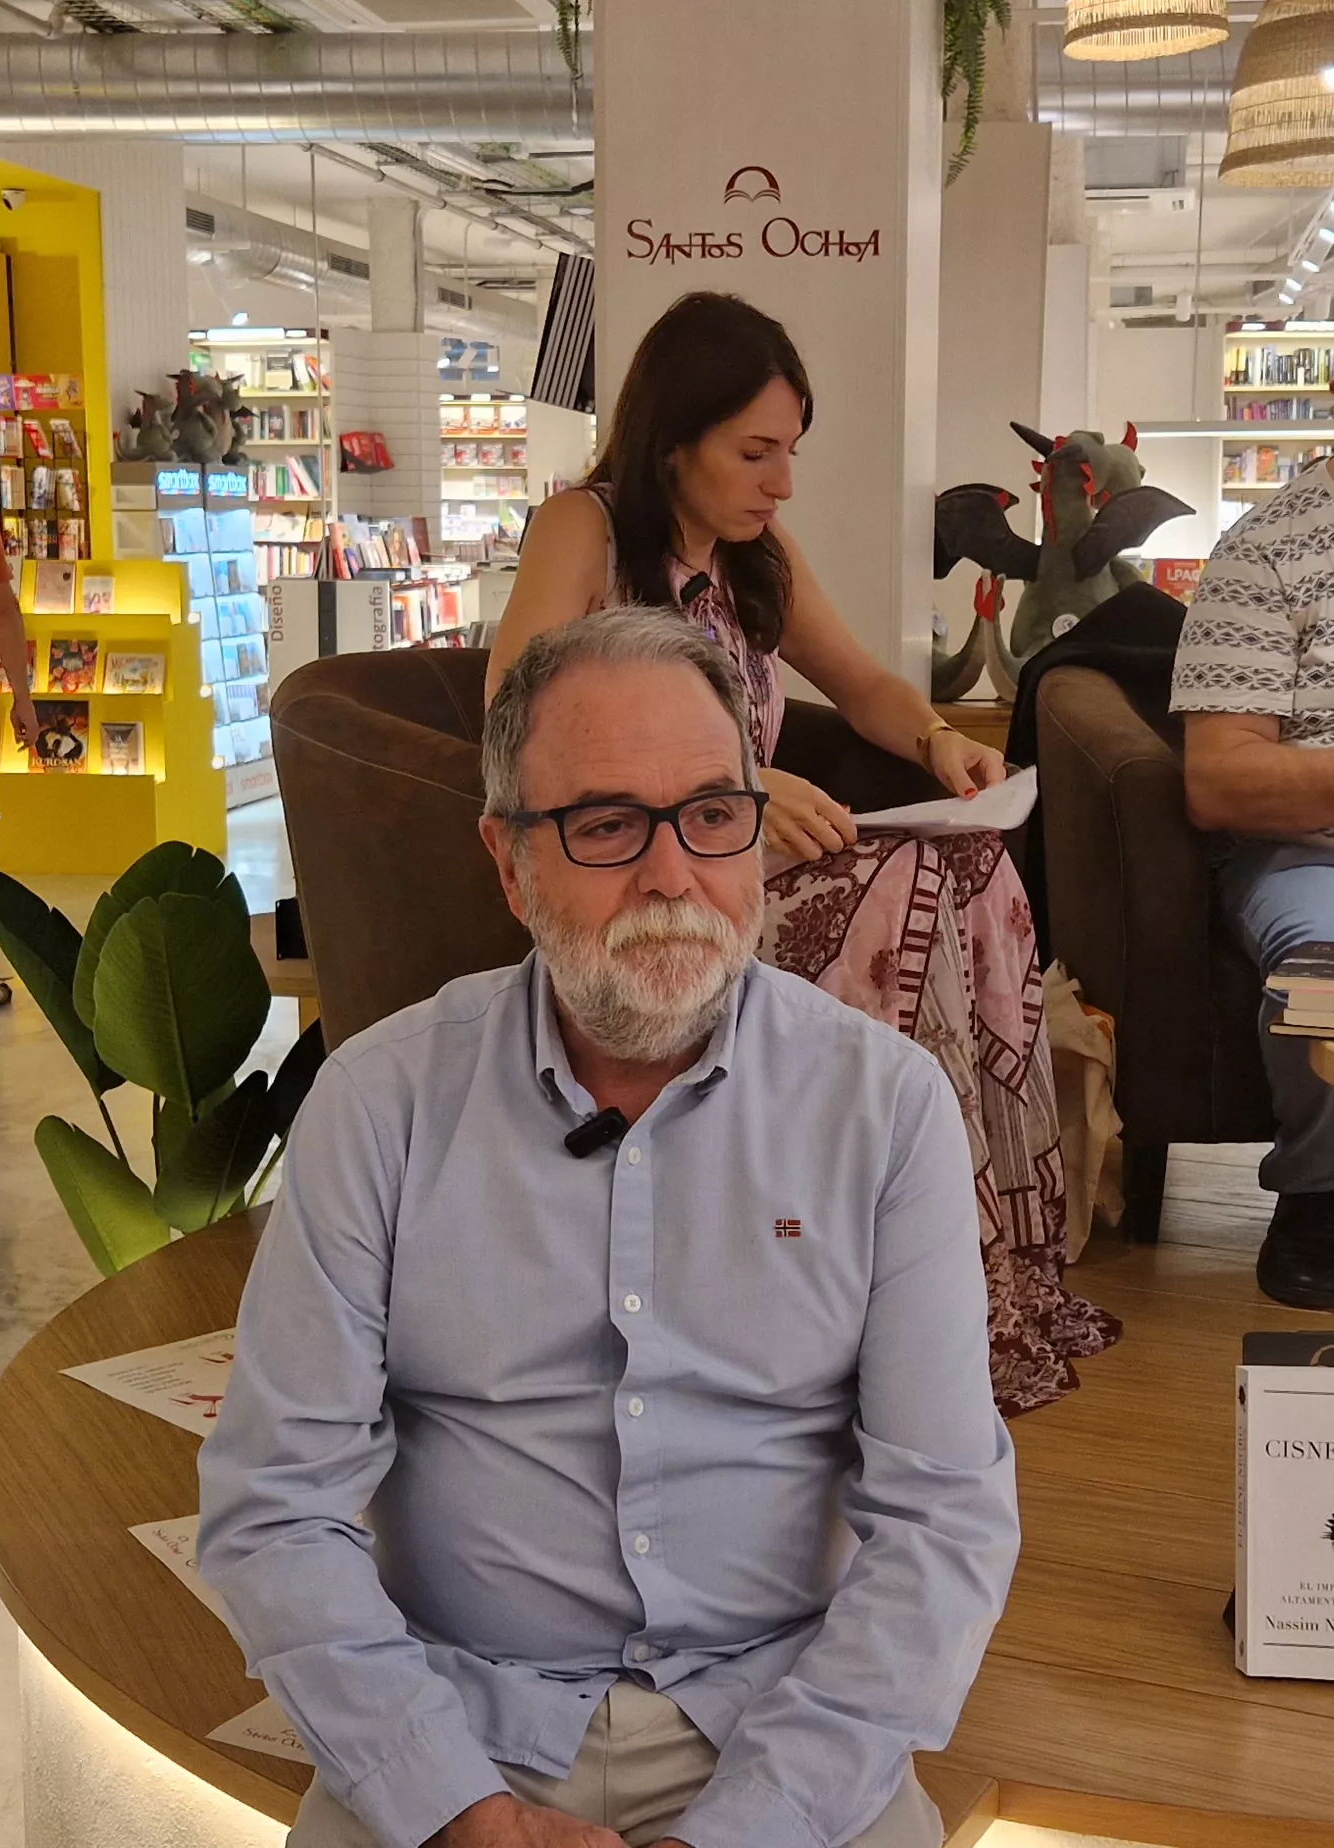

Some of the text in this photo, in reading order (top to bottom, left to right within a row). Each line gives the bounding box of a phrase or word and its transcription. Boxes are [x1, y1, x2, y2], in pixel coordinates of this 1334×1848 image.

[626, 216, 880, 265] SANTOS OCHOA
[270, 584, 284, 642] Diseño
[1300, 1581, 1312, 1590] EL
[1265, 1614, 1319, 1632] Nassim
